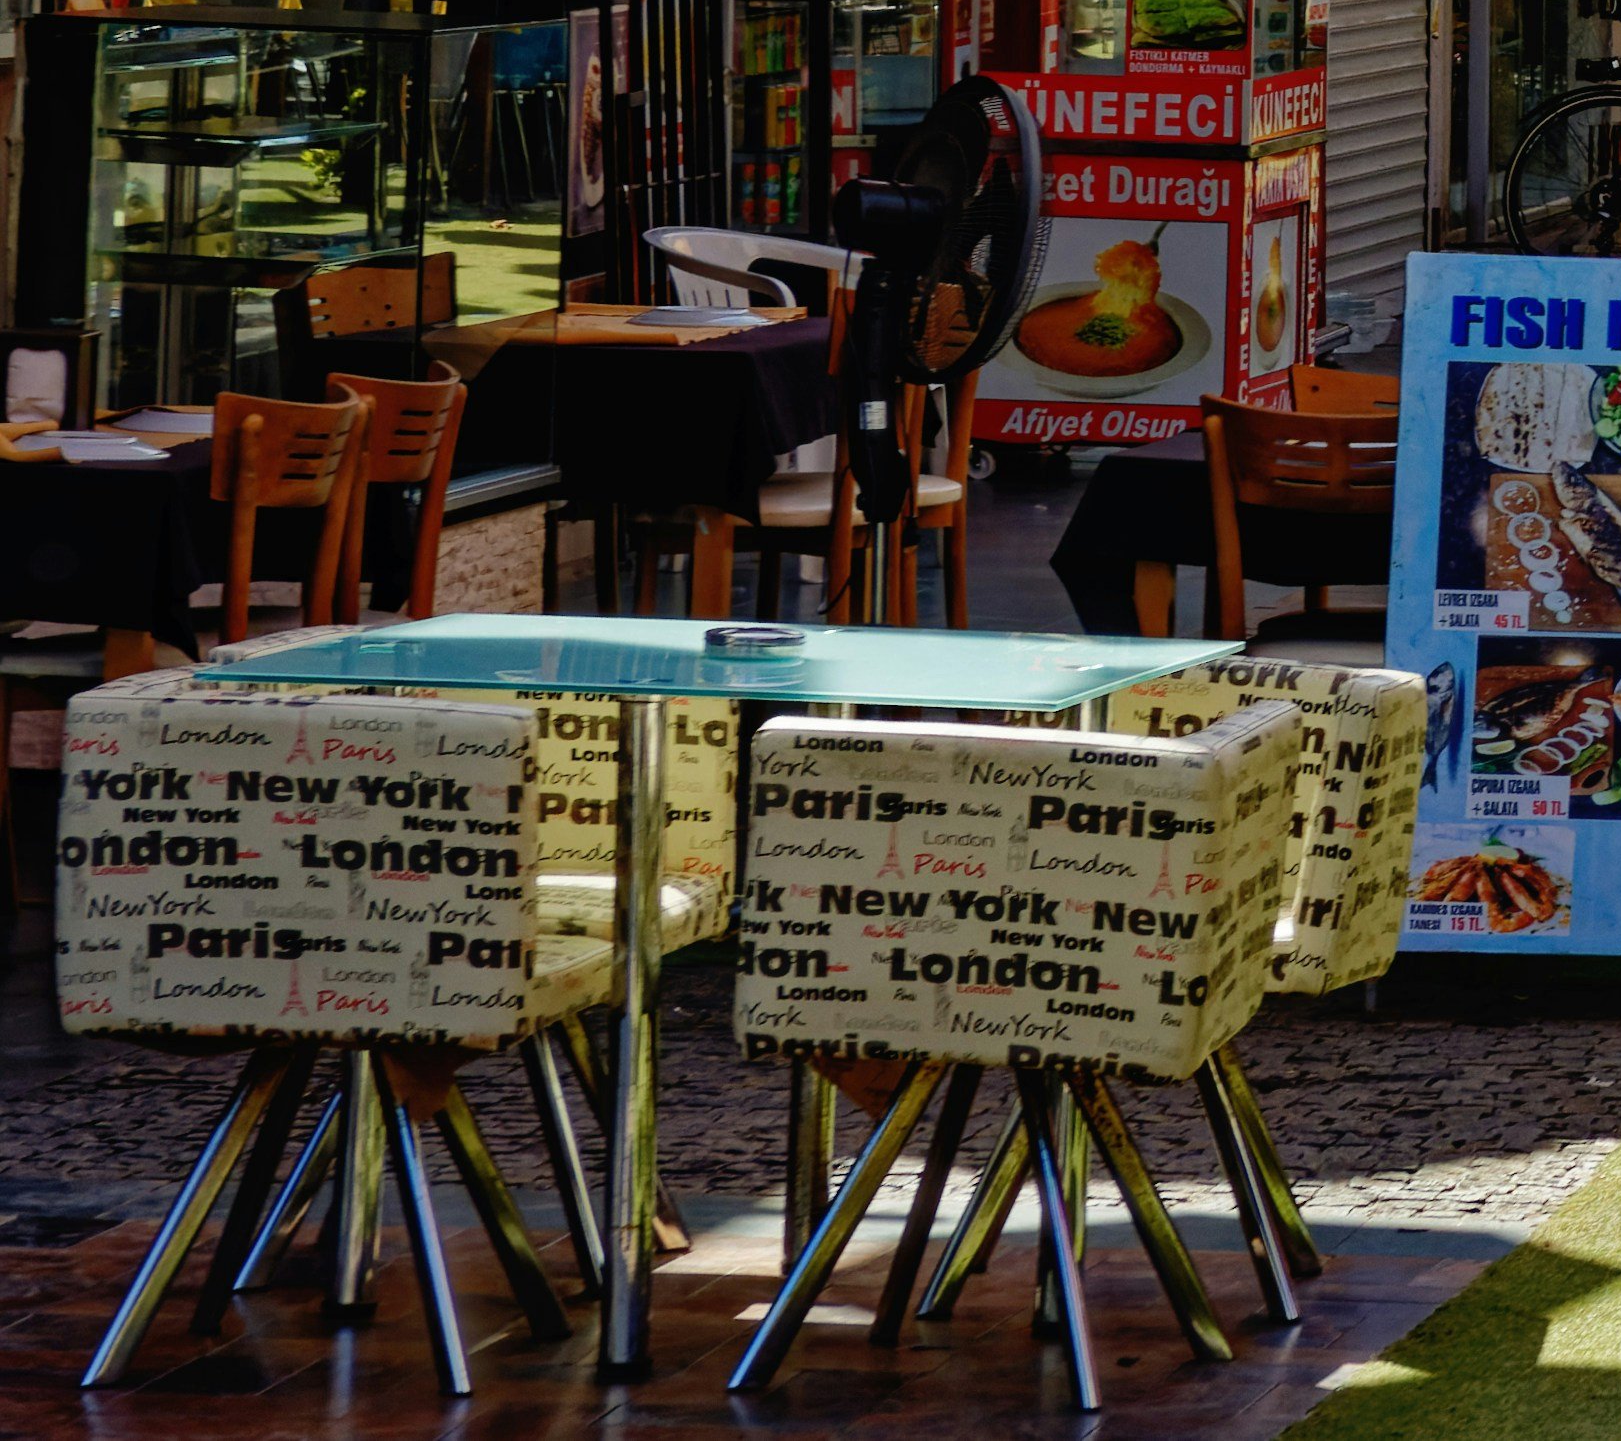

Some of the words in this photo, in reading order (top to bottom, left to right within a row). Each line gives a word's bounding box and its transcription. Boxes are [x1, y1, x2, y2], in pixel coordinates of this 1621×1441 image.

[1012, 79, 1235, 138] ÜNEFECİ
[1252, 71, 1325, 139] KÜNEFECİ
[1108, 164, 1231, 217] Durağı
[1450, 294, 1586, 351] FISH
[1001, 406, 1089, 442] Afiyet
[1100, 409, 1188, 441] Olsun
[1448, 613, 1480, 628] SALATA
[1494, 614, 1510, 628] 45
[321, 737, 398, 766] Paris
[794, 735, 884, 753] London
[1068, 748, 1158, 769] London
[753, 782, 905, 824] Paris
[1027, 795, 1177, 841] Paris
[1483, 801, 1519, 817] SALATA
[1532, 801, 1548, 816] 50
[301, 834, 521, 877] London
[913, 853, 987, 879] Paris
[184, 872, 280, 891] London
[817, 882, 931, 917] New
[147, 921, 304, 962] Paris
[1450, 917, 1465, 931] 15
[888, 945, 1101, 995] London
[776, 985, 868, 1004] London
[1046, 997, 1136, 1024] London
